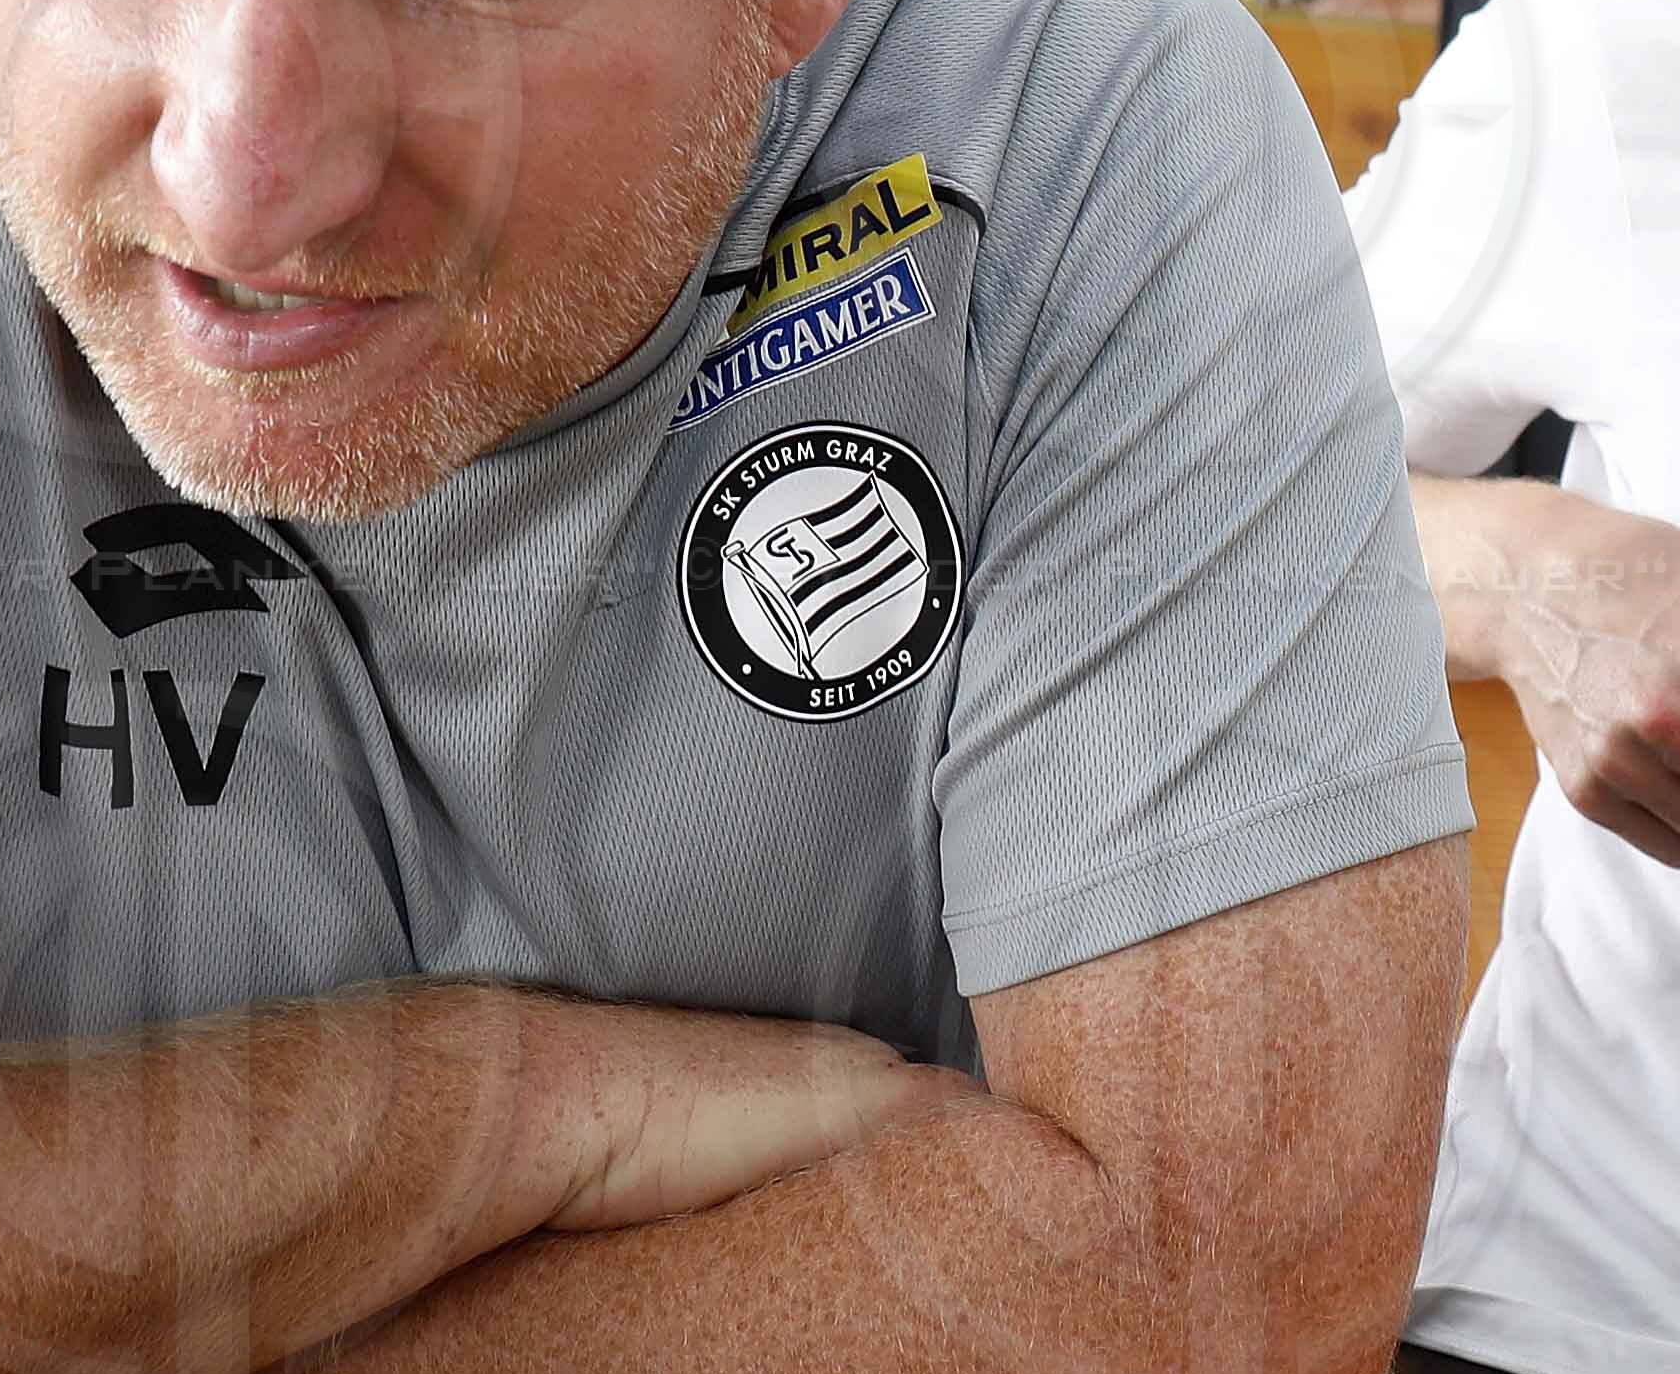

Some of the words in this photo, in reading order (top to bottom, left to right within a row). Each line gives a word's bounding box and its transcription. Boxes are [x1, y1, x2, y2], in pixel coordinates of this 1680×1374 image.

[712, 487, 742, 520] SK
[740, 440, 815, 490] STURM
[826, 439, 894, 472] GRAZ
[809, 682, 855, 707] SEIT
[866, 649, 912, 691] 1909
[38, 664, 267, 810] HV
